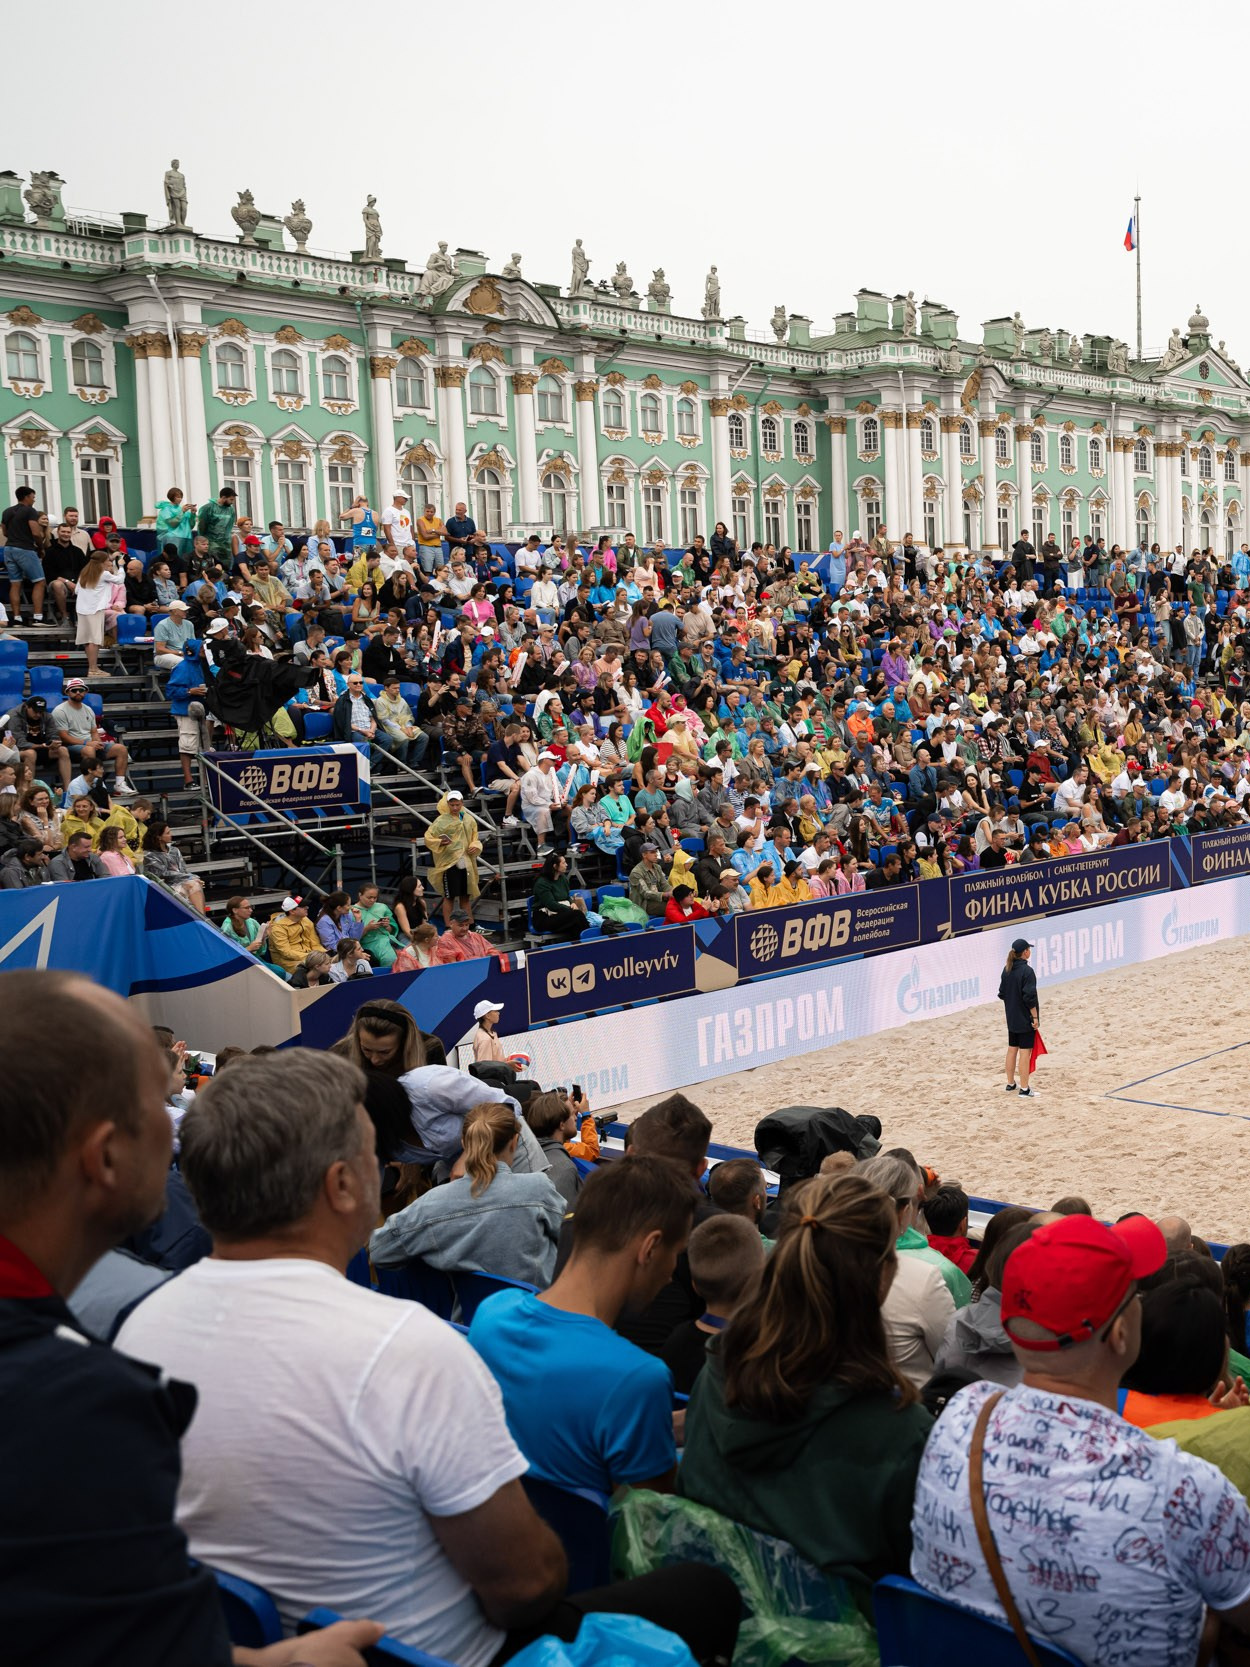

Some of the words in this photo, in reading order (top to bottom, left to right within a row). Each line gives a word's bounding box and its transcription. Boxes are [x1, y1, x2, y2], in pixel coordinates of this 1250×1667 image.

[270, 761, 341, 795] ВФВ
[1202, 836, 1231, 849] ПЛЯЖНЫЙ
[964, 876, 1005, 893] ПЛЯЖНЫЙ
[1006, 871, 1044, 886] ВОЛЕЙБОЛ
[1054, 857, 1110, 876] САНКТ-ПЕТЕРБУРГ
[964, 889, 1034, 921] ФИНАЛ
[1038, 877, 1091, 909] КУБКА
[1096, 863, 1161, 895] РОССИИ
[855, 916, 894, 931] федерация
[857, 902, 908, 918] Всероссийская
[781, 909, 852, 958] ВФВ
[853, 928, 890, 942] волейбола
[1179, 917, 1219, 944] ГАЗПРОМ
[603, 950, 679, 981] volleyvfv
[923, 976, 980, 1011] ГАЗПРОМ
[697, 985, 845, 1068] ГАЗПРОМ
